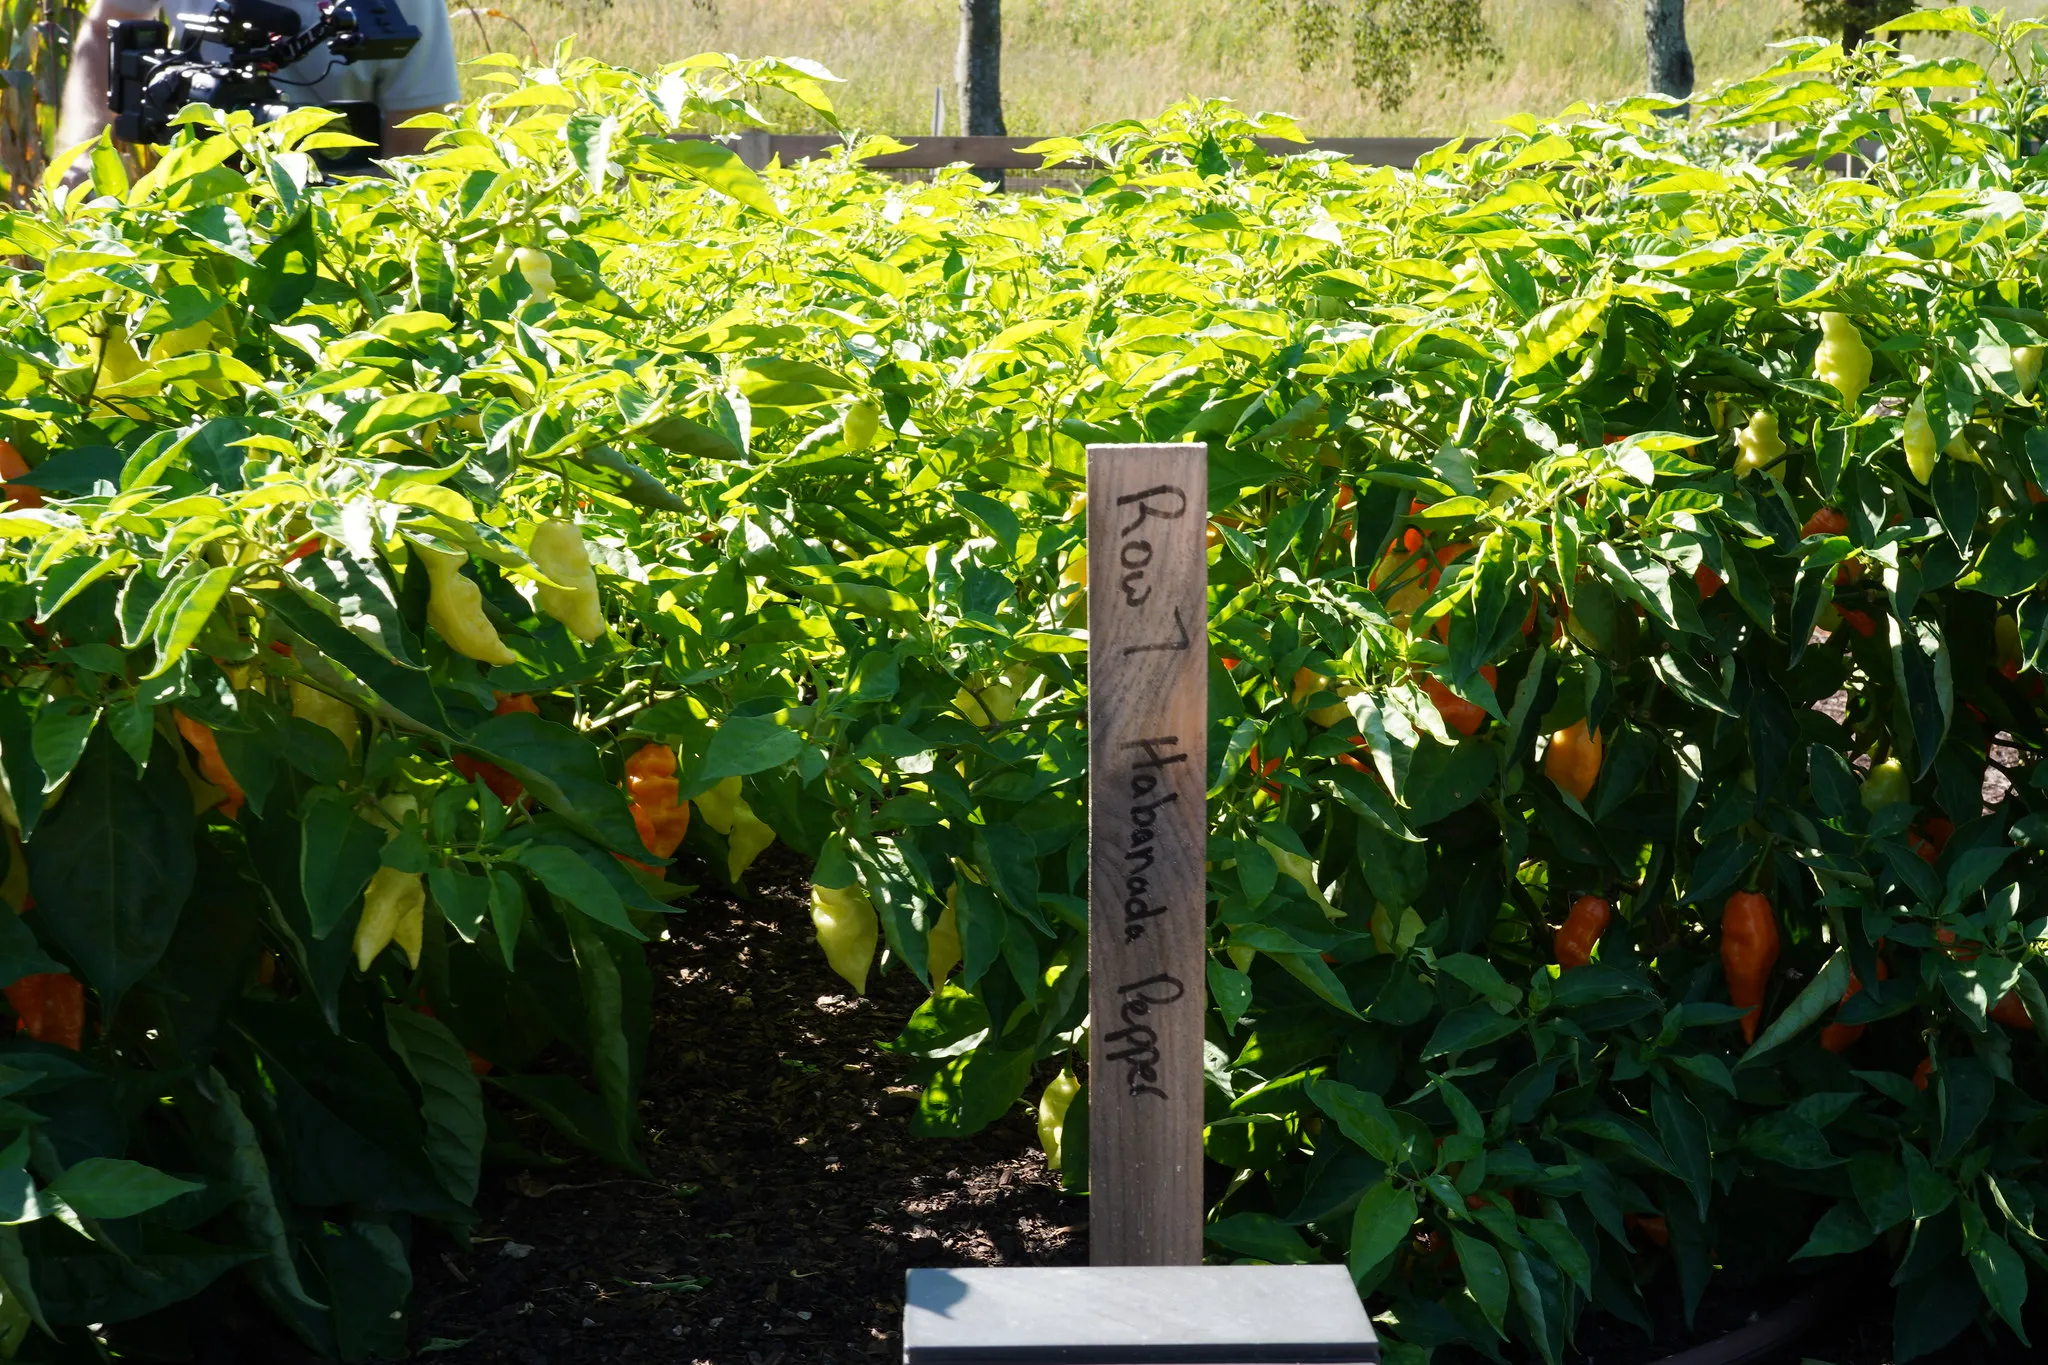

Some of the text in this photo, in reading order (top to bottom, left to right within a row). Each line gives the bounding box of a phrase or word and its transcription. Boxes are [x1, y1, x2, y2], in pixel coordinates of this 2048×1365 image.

[1104, 485, 1190, 1099] Row 7 Habanada Pepper
